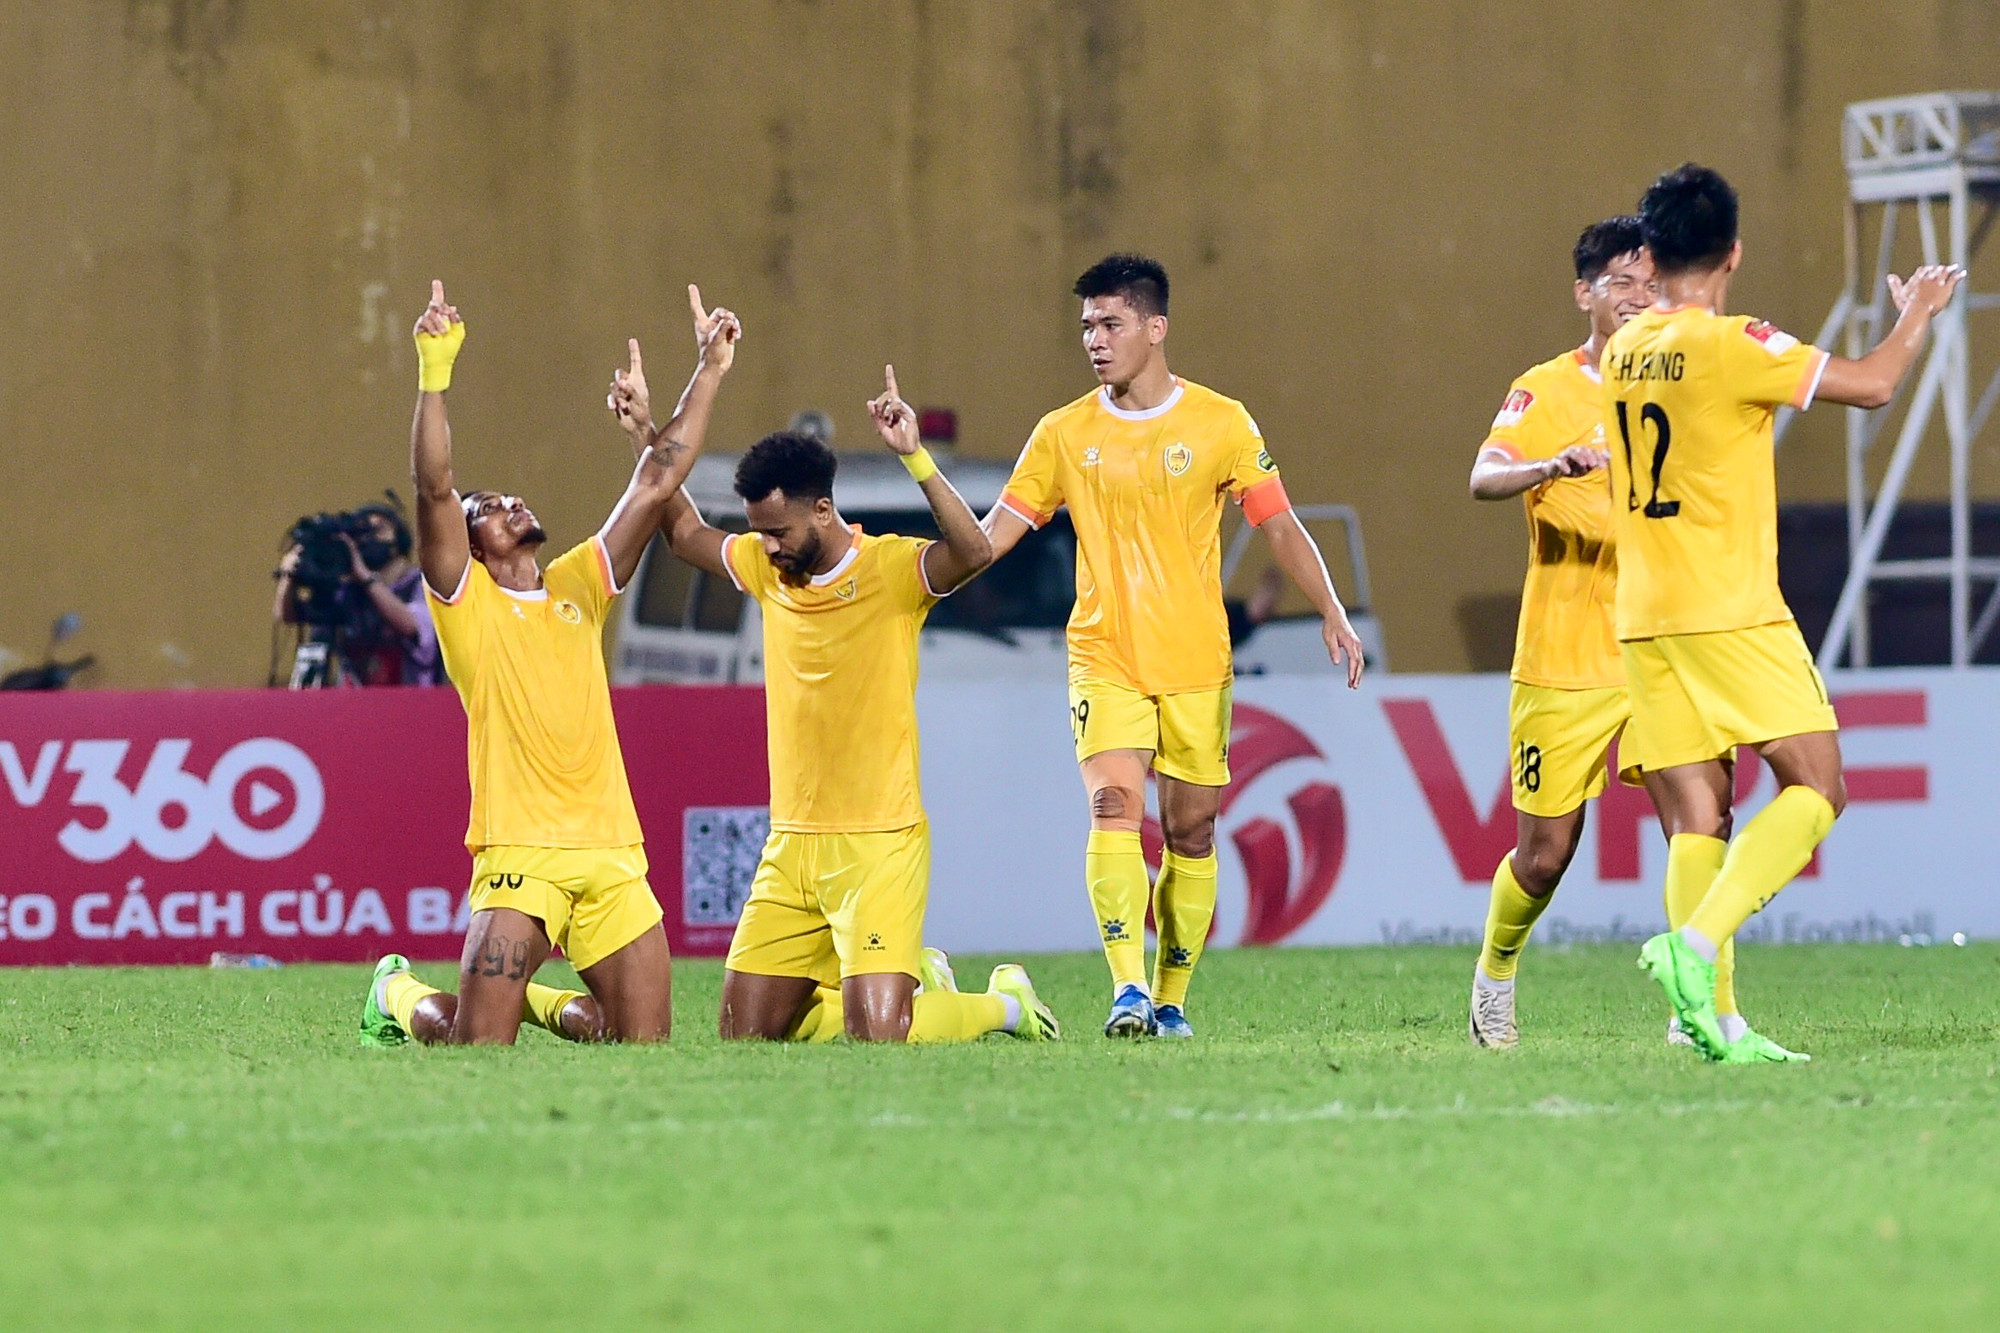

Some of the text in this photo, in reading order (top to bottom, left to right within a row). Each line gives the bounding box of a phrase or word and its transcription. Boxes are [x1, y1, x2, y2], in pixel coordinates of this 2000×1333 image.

[1616, 401, 1680, 519] 12
[1519, 741, 1541, 793] 18
[0, 893, 58, 940] O
[71, 875, 246, 939] CÁCH
[259, 873, 394, 937] CỦA
